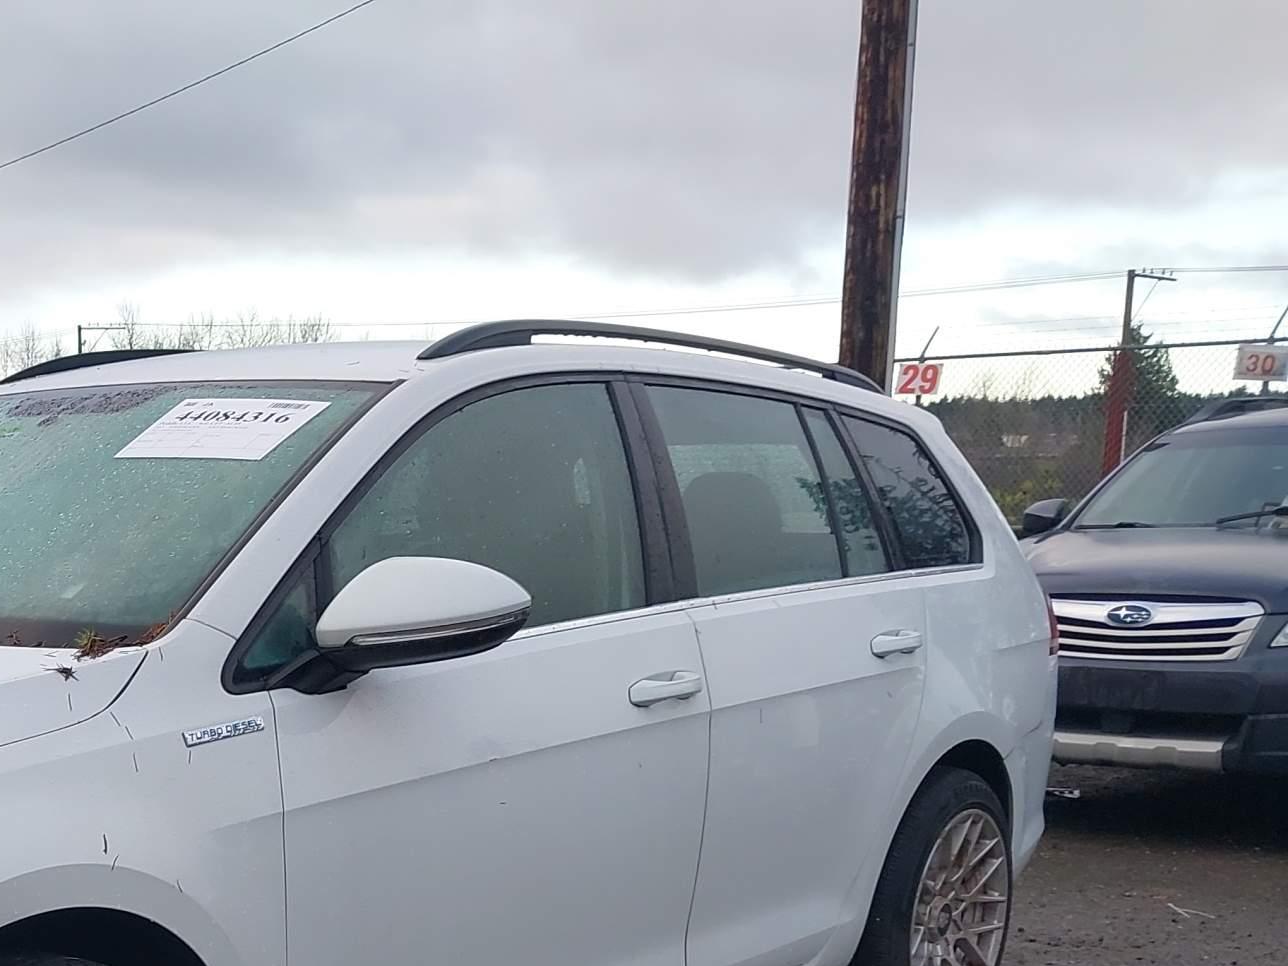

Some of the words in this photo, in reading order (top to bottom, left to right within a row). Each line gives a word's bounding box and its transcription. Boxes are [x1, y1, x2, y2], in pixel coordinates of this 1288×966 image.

[1246, 354, 1276, 375] 30
[898, 364, 939, 394] 29
[176, 410, 294, 424] 44084316
[188, 727, 224, 742] TURBO
[225, 719, 261, 735] DIESEL
